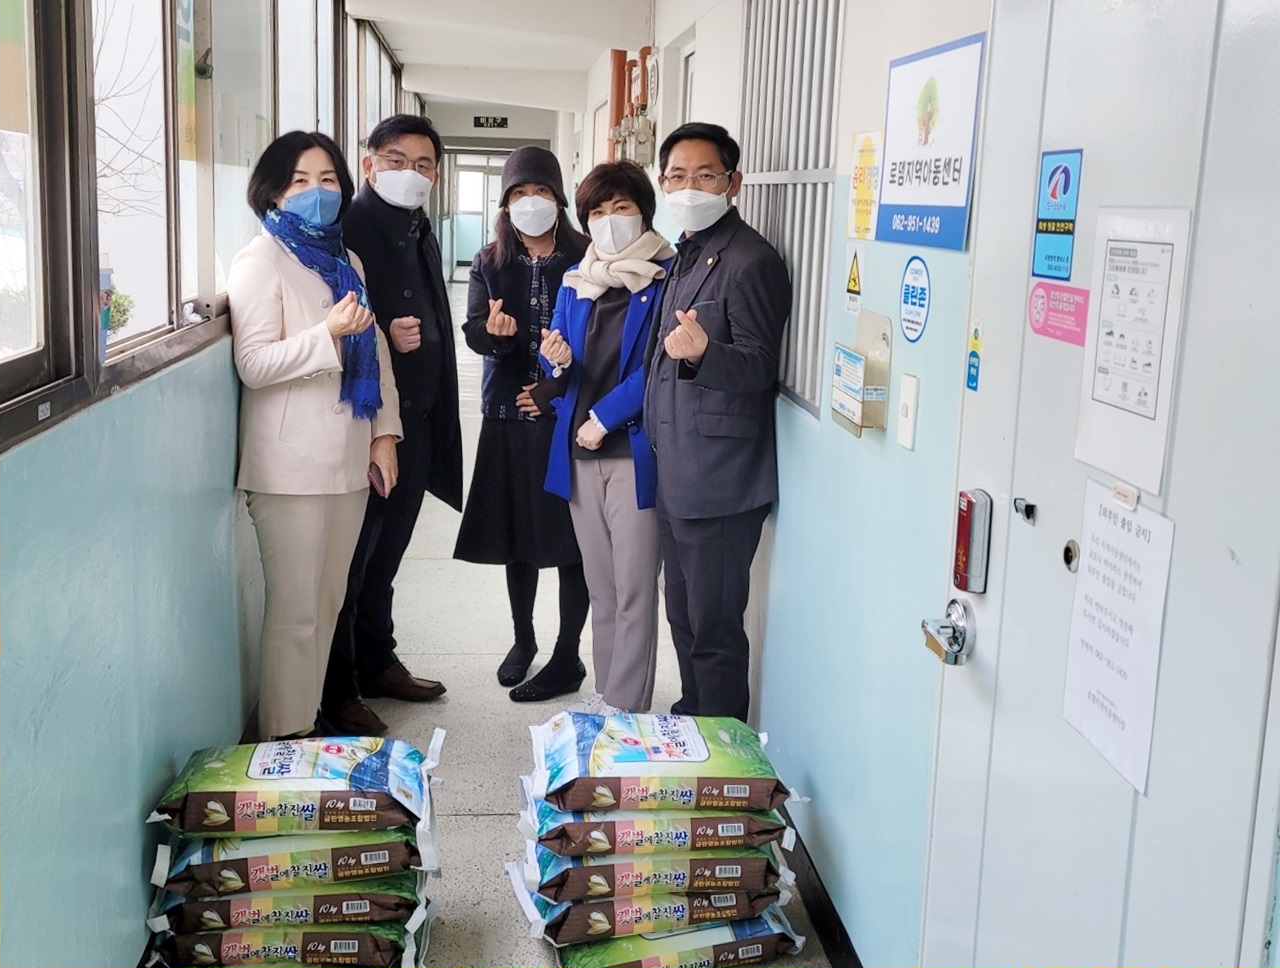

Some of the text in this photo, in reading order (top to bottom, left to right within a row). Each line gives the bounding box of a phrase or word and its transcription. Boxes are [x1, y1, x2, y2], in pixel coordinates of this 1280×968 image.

[889, 156, 963, 187] 로뎀지역아동센터
[892, 214, 940, 234] 062-951-1439
[903, 284, 927, 308] 클린존
[1121, 518, 1133, 533] 출입
